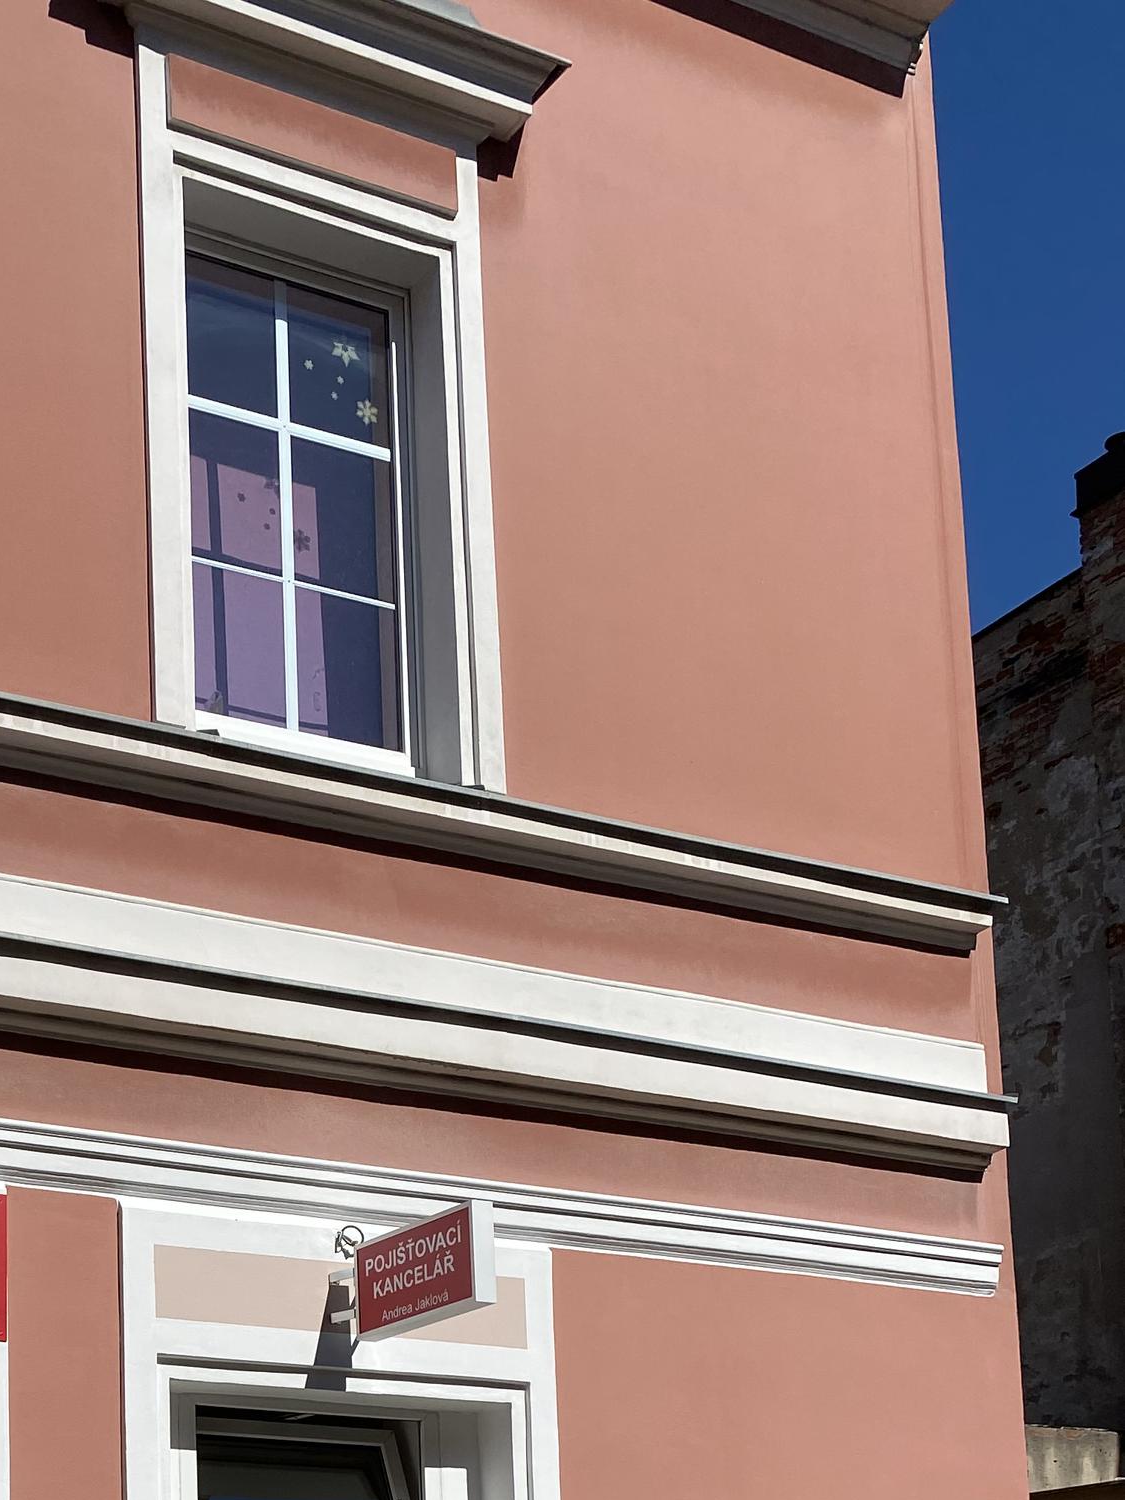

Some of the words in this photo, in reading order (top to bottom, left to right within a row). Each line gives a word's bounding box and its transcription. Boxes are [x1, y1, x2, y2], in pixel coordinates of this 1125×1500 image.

[366, 1220, 461, 1277] POJIŠŤOVACÍ
[373, 1250, 455, 1299] KANCELÁŘ
[382, 1303, 412, 1321] Andrea
